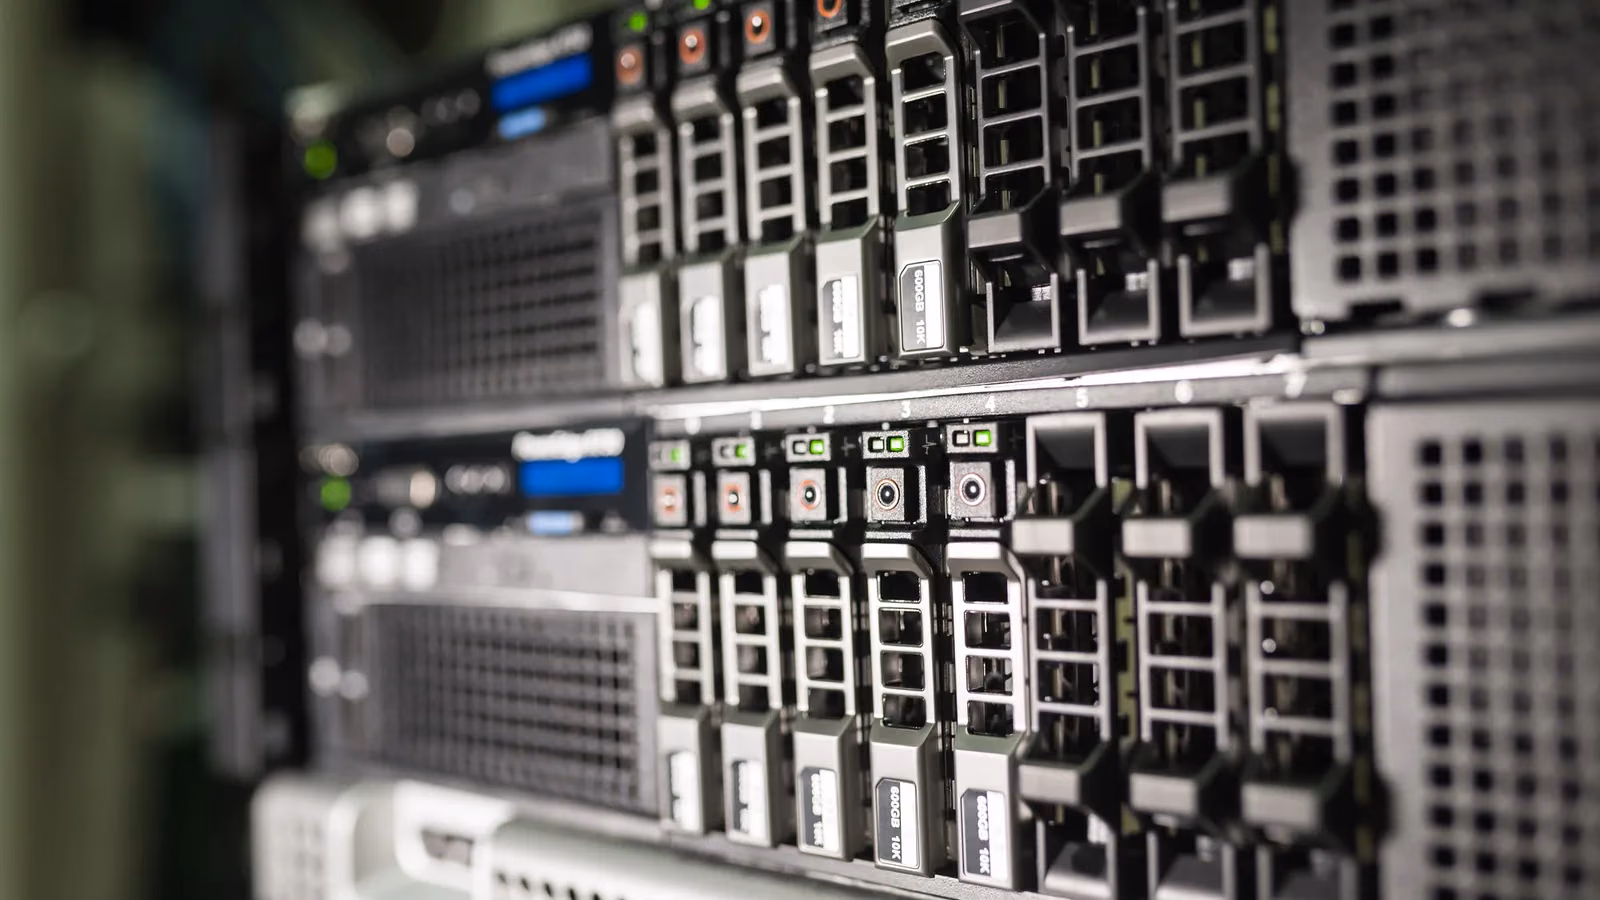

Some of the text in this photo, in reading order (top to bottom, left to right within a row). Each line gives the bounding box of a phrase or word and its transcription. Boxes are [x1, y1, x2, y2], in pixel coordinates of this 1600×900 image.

[914, 269, 926, 345] 600GB 10K
[823, 405, 835, 425] 2
[901, 400, 911, 418] 3
[984, 395, 996, 412] 4
[1076, 387, 1088, 408] 5
[890, 786, 902, 860] 600GB 10K
[977, 795, 990, 874] 600GB 10K
